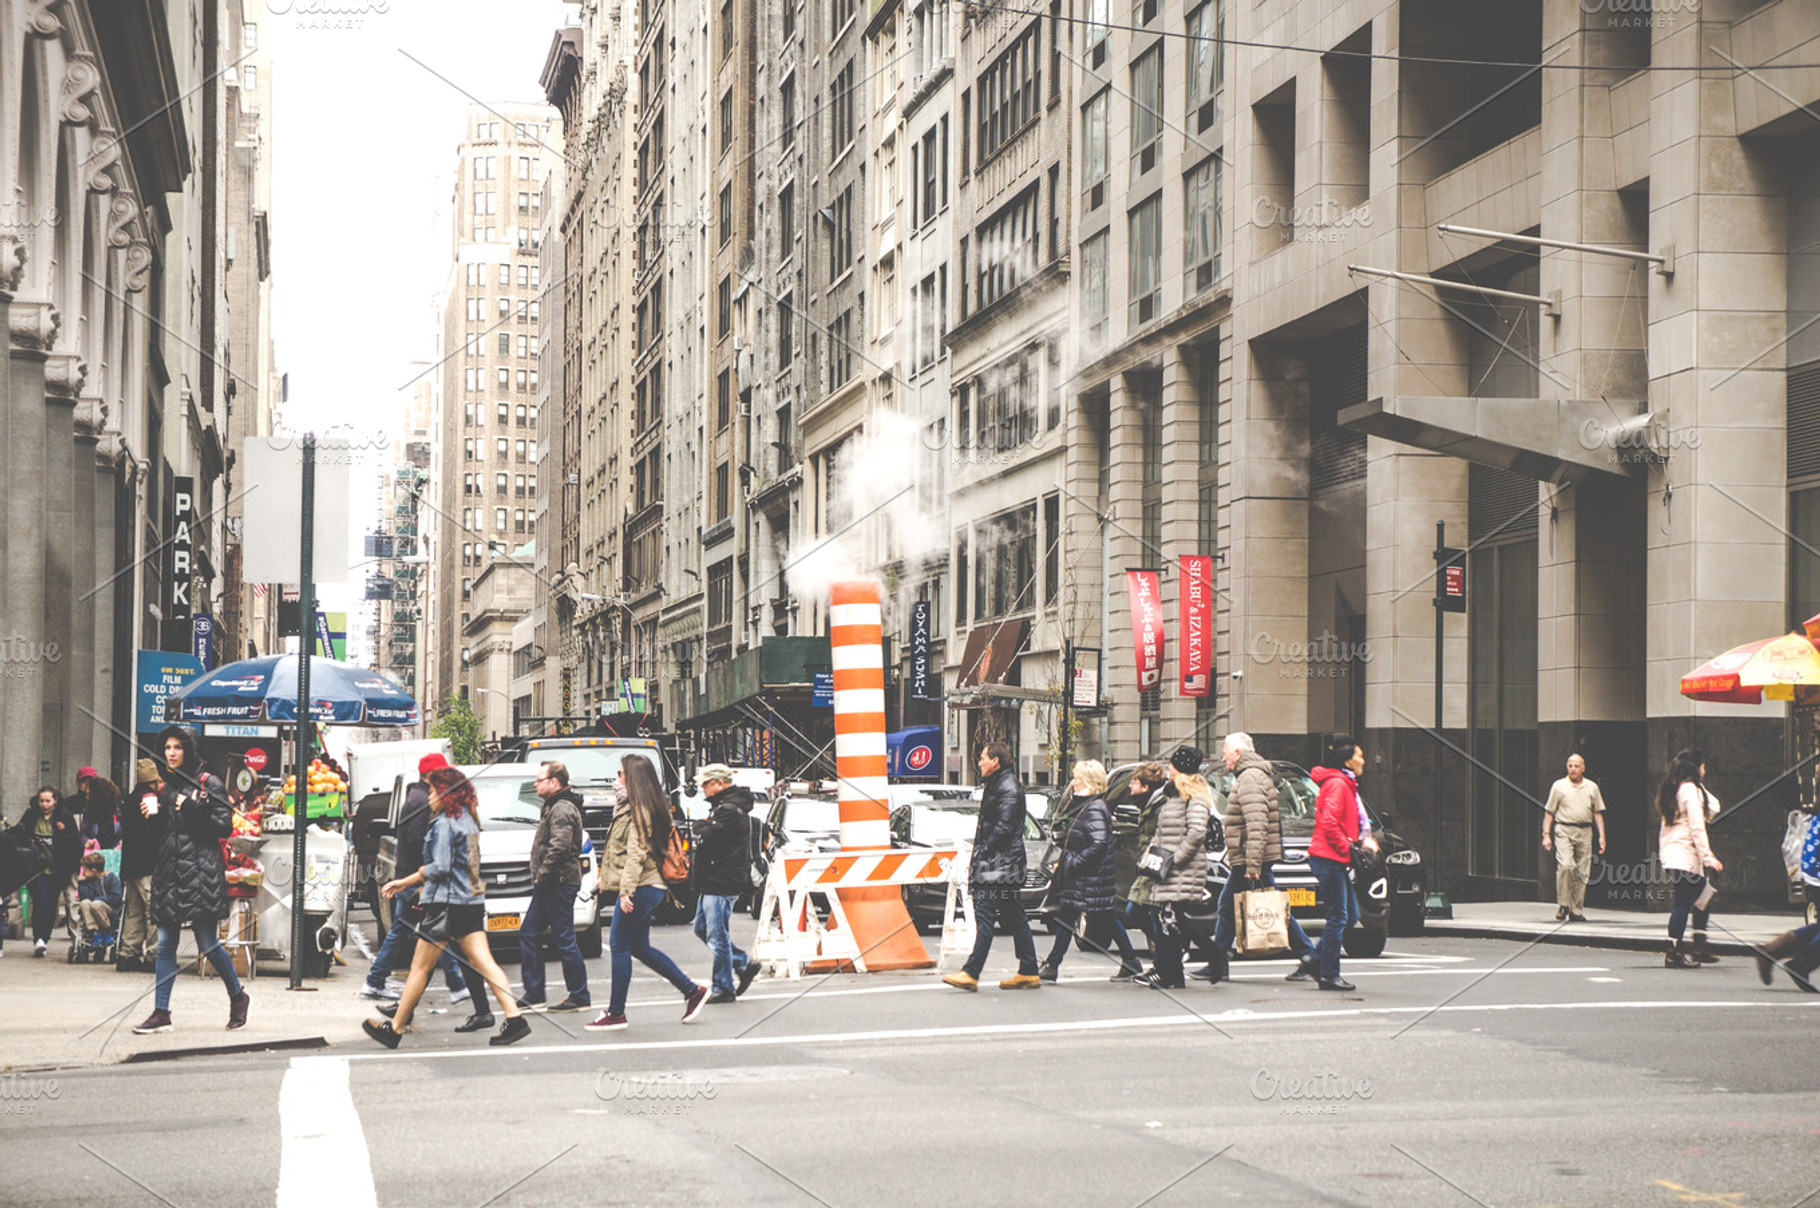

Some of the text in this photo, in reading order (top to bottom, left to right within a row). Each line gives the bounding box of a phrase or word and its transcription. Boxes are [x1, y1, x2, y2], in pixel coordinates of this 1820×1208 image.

[173, 493, 192, 619] PARK
[914, 604, 926, 653] TOYAMA
[1189, 616, 1202, 672] IZAKAYA
[162, 675, 182, 684] FILM
[914, 656, 926, 694] SUSHI
[143, 684, 166, 694] COLD
[202, 708, 226, 716] FRESH
[227, 706, 249, 715] FRUIT
[224, 726, 259, 735] TITAN
